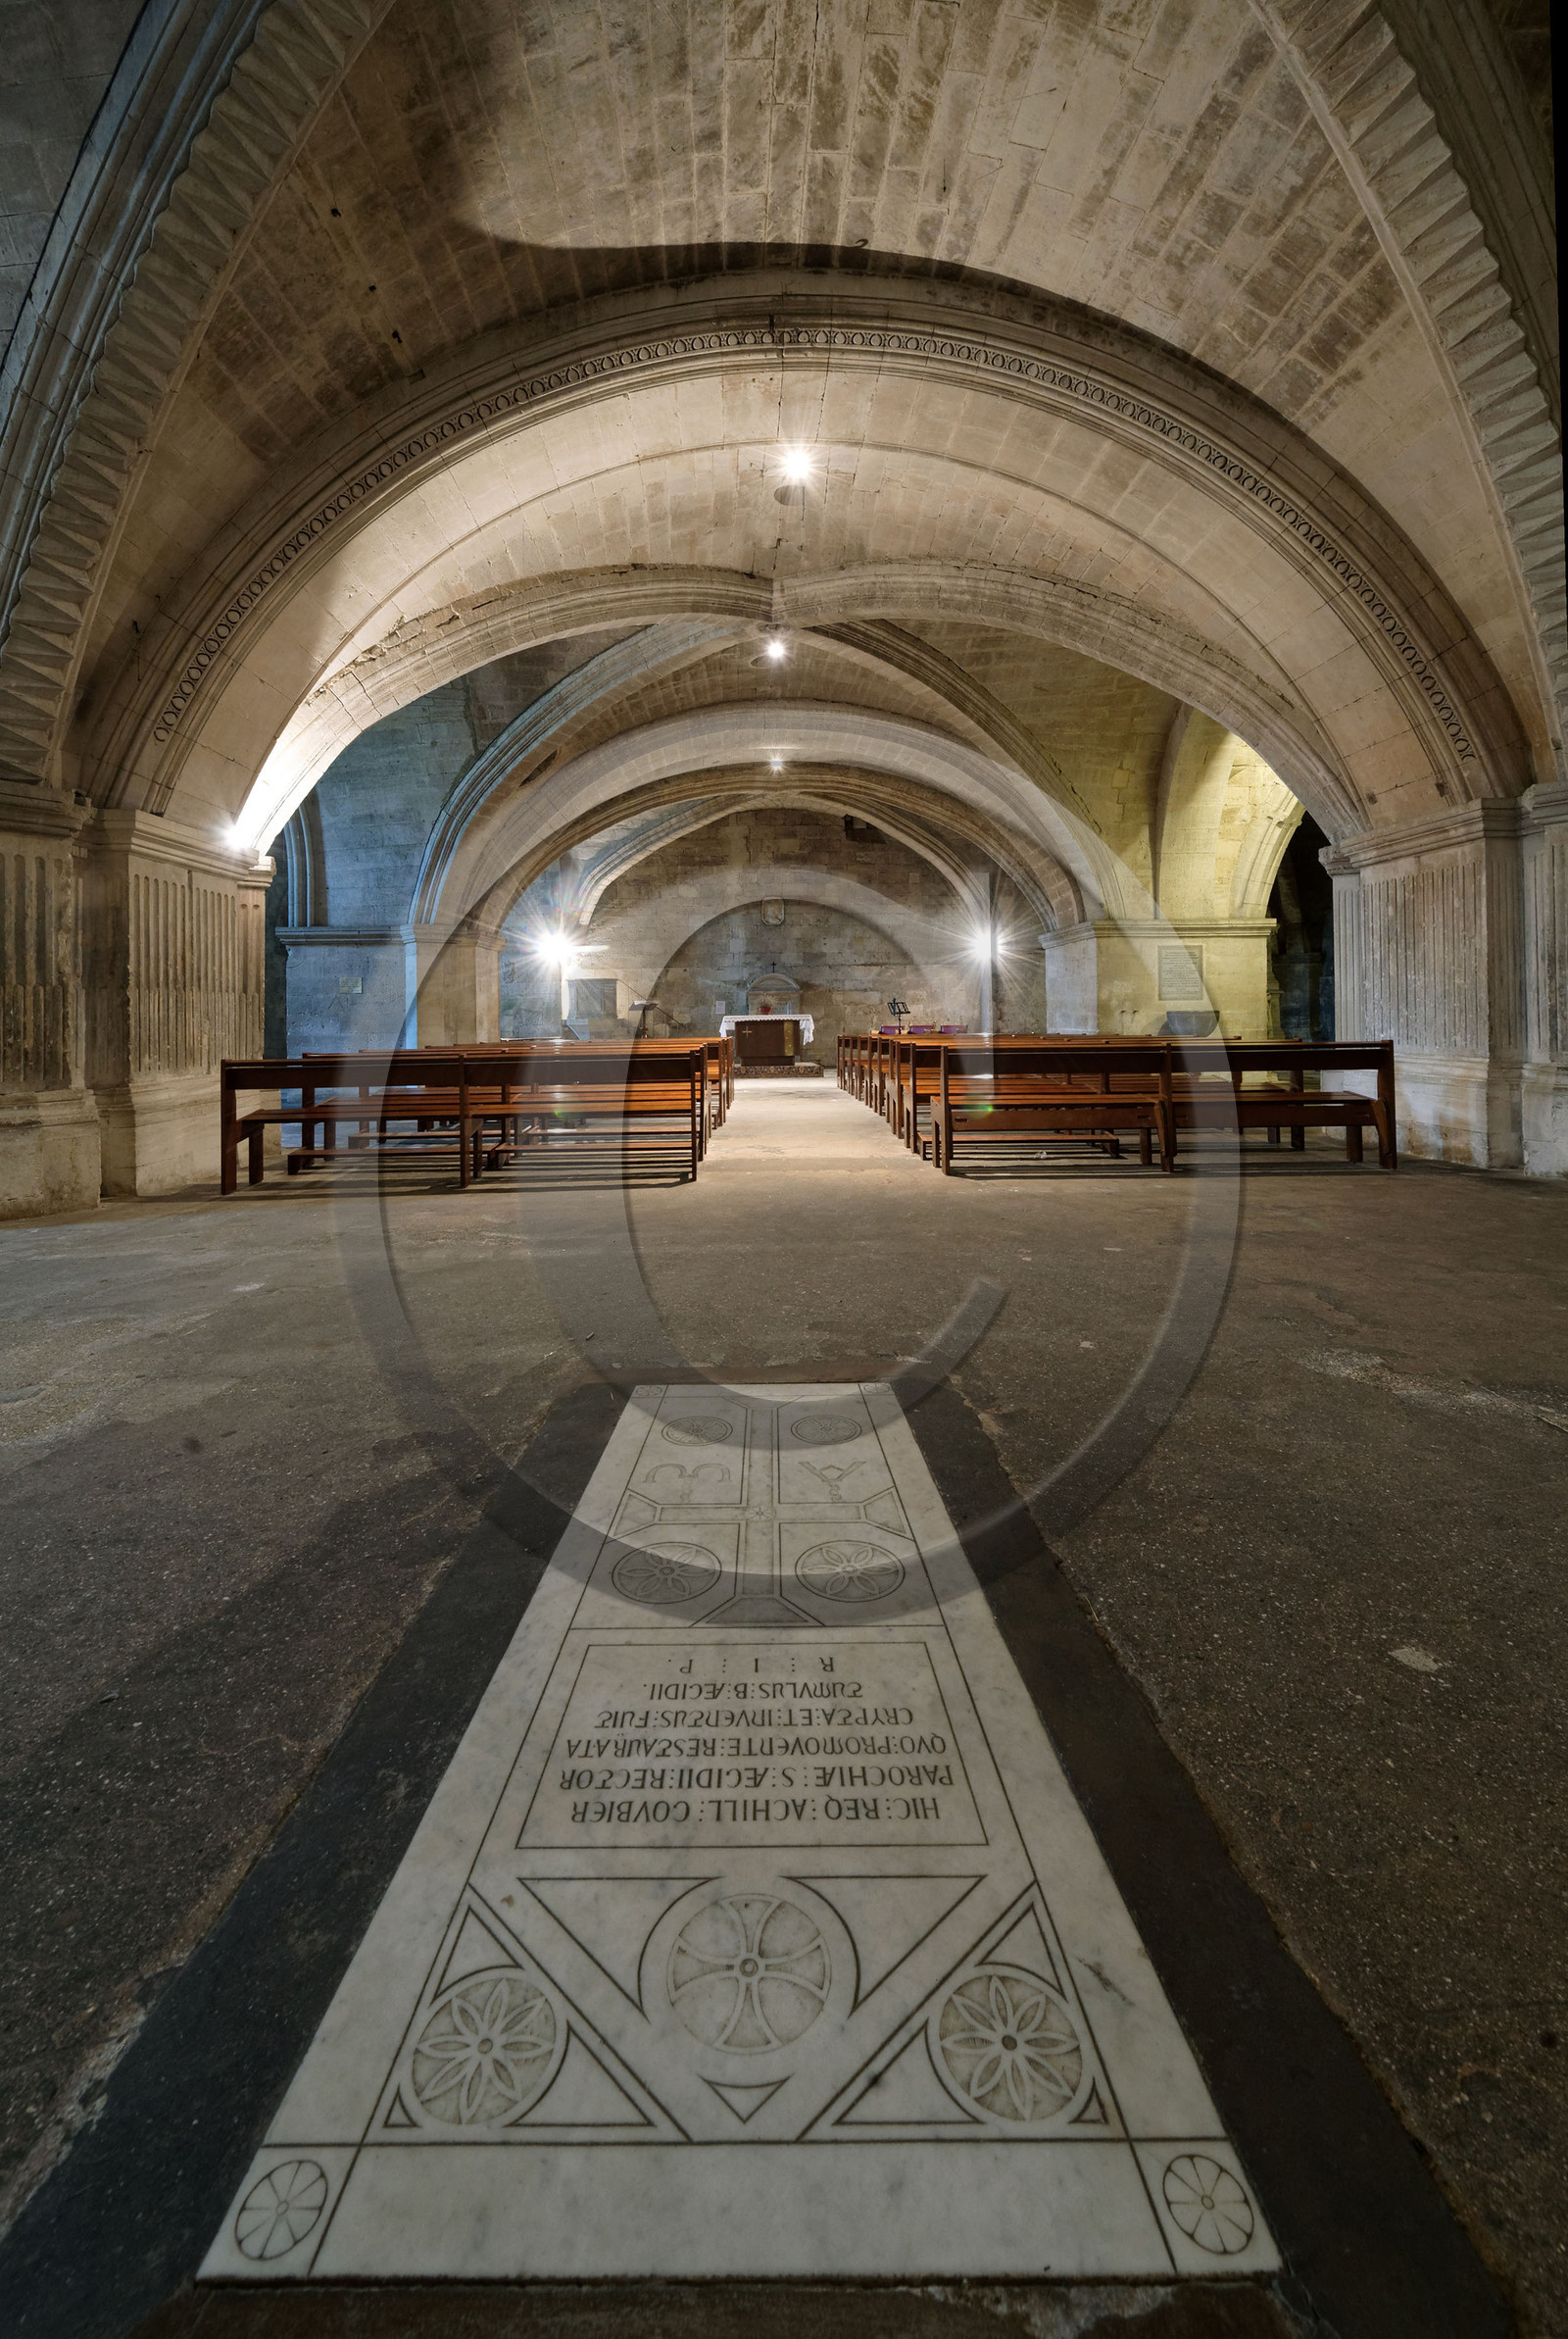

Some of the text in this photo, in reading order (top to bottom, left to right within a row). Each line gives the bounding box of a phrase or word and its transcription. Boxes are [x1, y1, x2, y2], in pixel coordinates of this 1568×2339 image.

[818, 1656, 836, 1673] R
[733, 1682, 749, 1700] B
[782, 1708, 813, 1727] ET
[820, 1707, 914, 1726] CRYPTA
[559, 1767, 667, 1791] RECTOR
[781, 1767, 797, 1788] S
[708, 1798, 808, 1823] ACHILL
[823, 1794, 881, 1821] REQ
[892, 1797, 941, 1820] HIC
